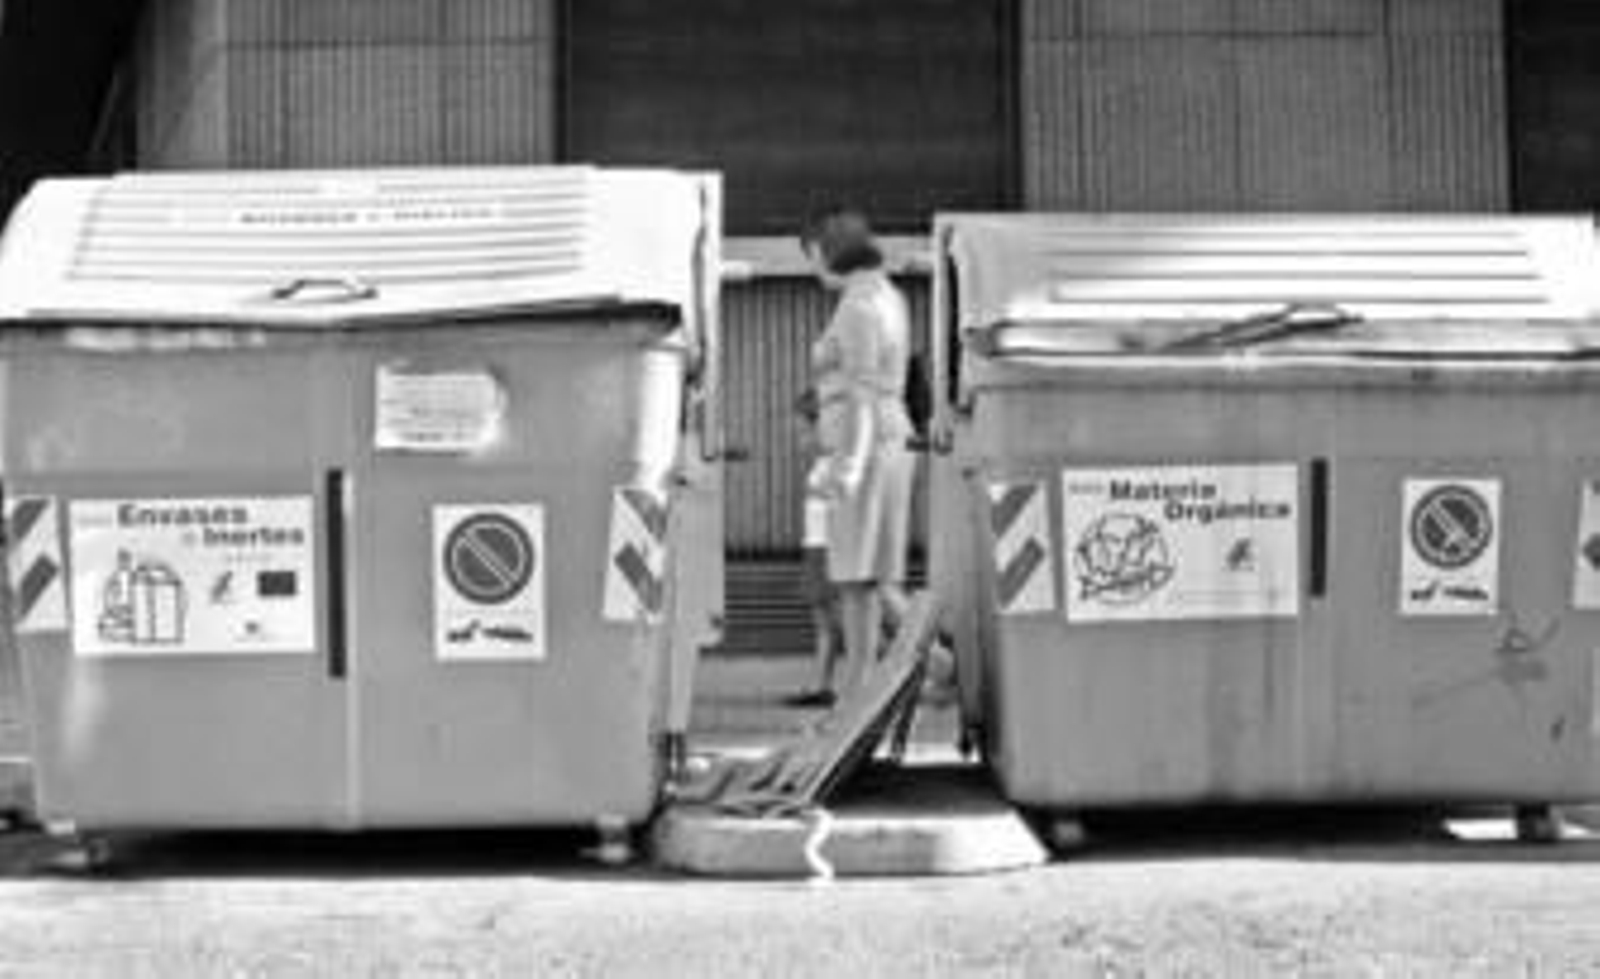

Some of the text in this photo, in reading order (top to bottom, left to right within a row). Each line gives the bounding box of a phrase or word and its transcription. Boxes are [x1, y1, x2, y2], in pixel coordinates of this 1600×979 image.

[1110, 479, 1217, 501] Materia
[117, 503, 249, 526] Envases
[202, 527, 305, 546] Inertes
